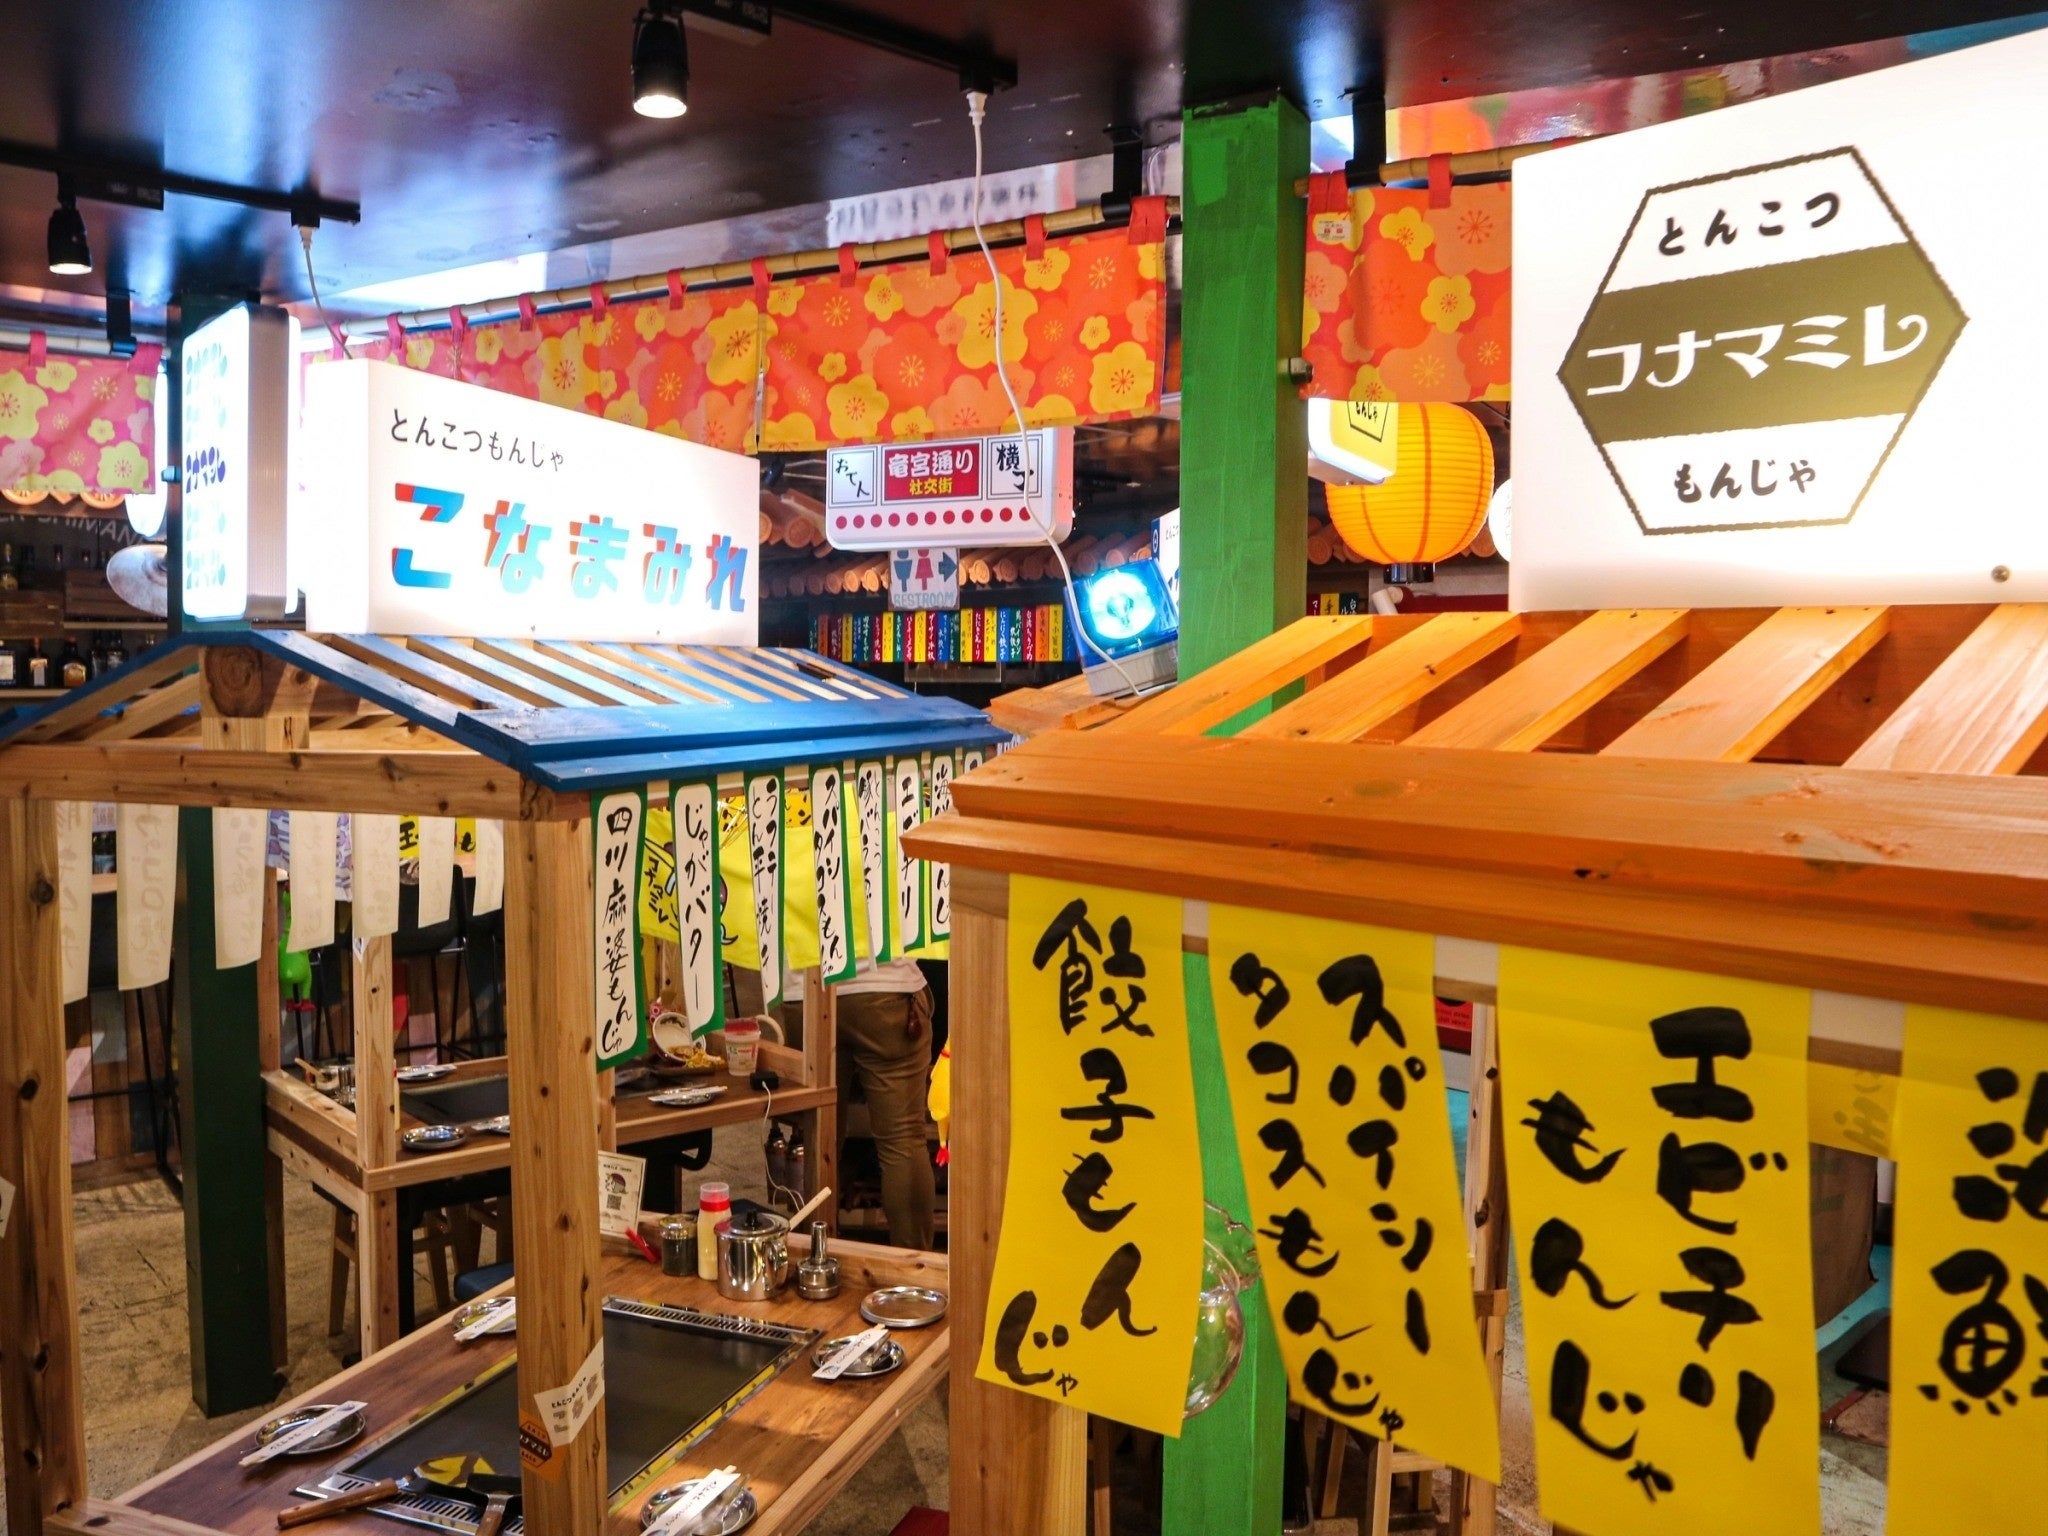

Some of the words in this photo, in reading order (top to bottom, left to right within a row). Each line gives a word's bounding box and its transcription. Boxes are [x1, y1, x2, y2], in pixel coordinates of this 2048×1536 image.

[1657, 191, 1842, 256] とんこつ
[1586, 304, 1928, 397] コナマミレ
[389, 408, 566, 474] とんこつもんじゃ
[888, 448, 974, 479] 竜宮通り
[909, 477, 953, 496] 社交街
[995, 443, 1035, 491] 横丁
[1673, 459, 1817, 504] もんじゃ
[393, 481, 749, 613] こなまみれ
[894, 591, 954, 607] RESTROOM
[821, 773, 840, 902] スパイシー
[600, 806, 634, 1054] 四川麻婆もんじゃ
[684, 803, 712, 1012] じゃがバター
[994, 898, 1158, 1397] 餃子もんじゃ
[1229, 952, 1404, 1442] タコスもんじゃ
[1316, 954, 1433, 1355] スパイシー
[1521, 1090, 1676, 1502] もんじゃ
[1649, 1006, 1789, 1461] エビチリ
